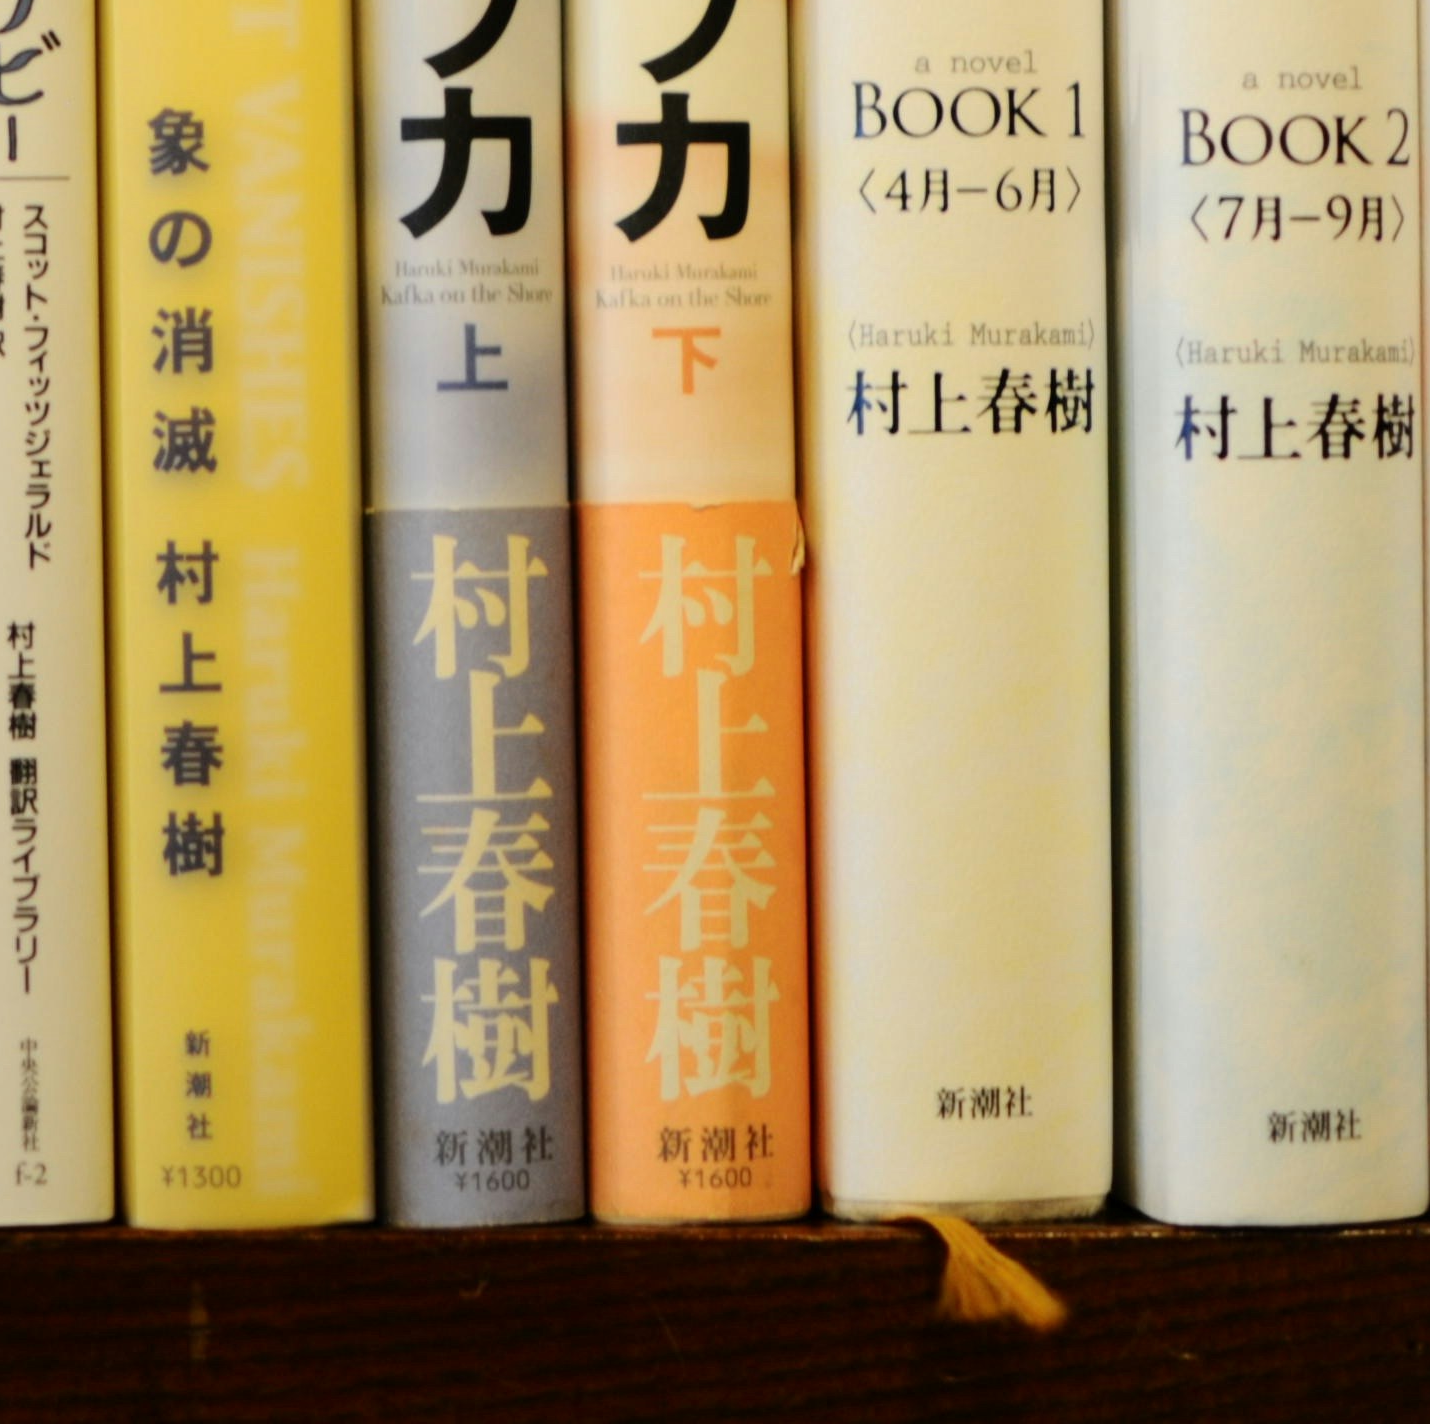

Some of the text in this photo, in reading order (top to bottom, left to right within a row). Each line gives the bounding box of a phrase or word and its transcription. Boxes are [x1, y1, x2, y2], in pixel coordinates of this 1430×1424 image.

[915, 50, 1039, 74] a novel
[1242, 67, 1363, 91] a novel
[852, 81, 1085, 139] BOOK 1
[1179, 108, 1411, 167] BOOK 2
[147, 106, 218, 475] 象の消滅
[380, 284, 434, 307] Kafka
[472, 282, 502, 304] the
[508, 282, 553, 304] Shore
[595, 288, 650, 311] Kafka
[688, 287, 719, 308] the
[724, 287, 772, 307] Shore
[436, 322, 509, 393] 上
[652, 326, 721, 395] 下
[846, 367, 1095, 437] 村上春樹
[1174, 392, 1416, 462] 村上春樹
[154, 538, 227, 878] 村上春樹
[410, 533, 560, 1105] 村上春樹
[637, 533, 781, 1104] 村上春樹
[184, 1029, 213, 1141] 新潮社
[936, 1085, 1034, 1121] 新潮社
[434, 1123, 555, 1168] 新潮社
[656, 1123, 776, 1165] 新潮社
[1268, 1108, 1362, 1144] 新潮社
